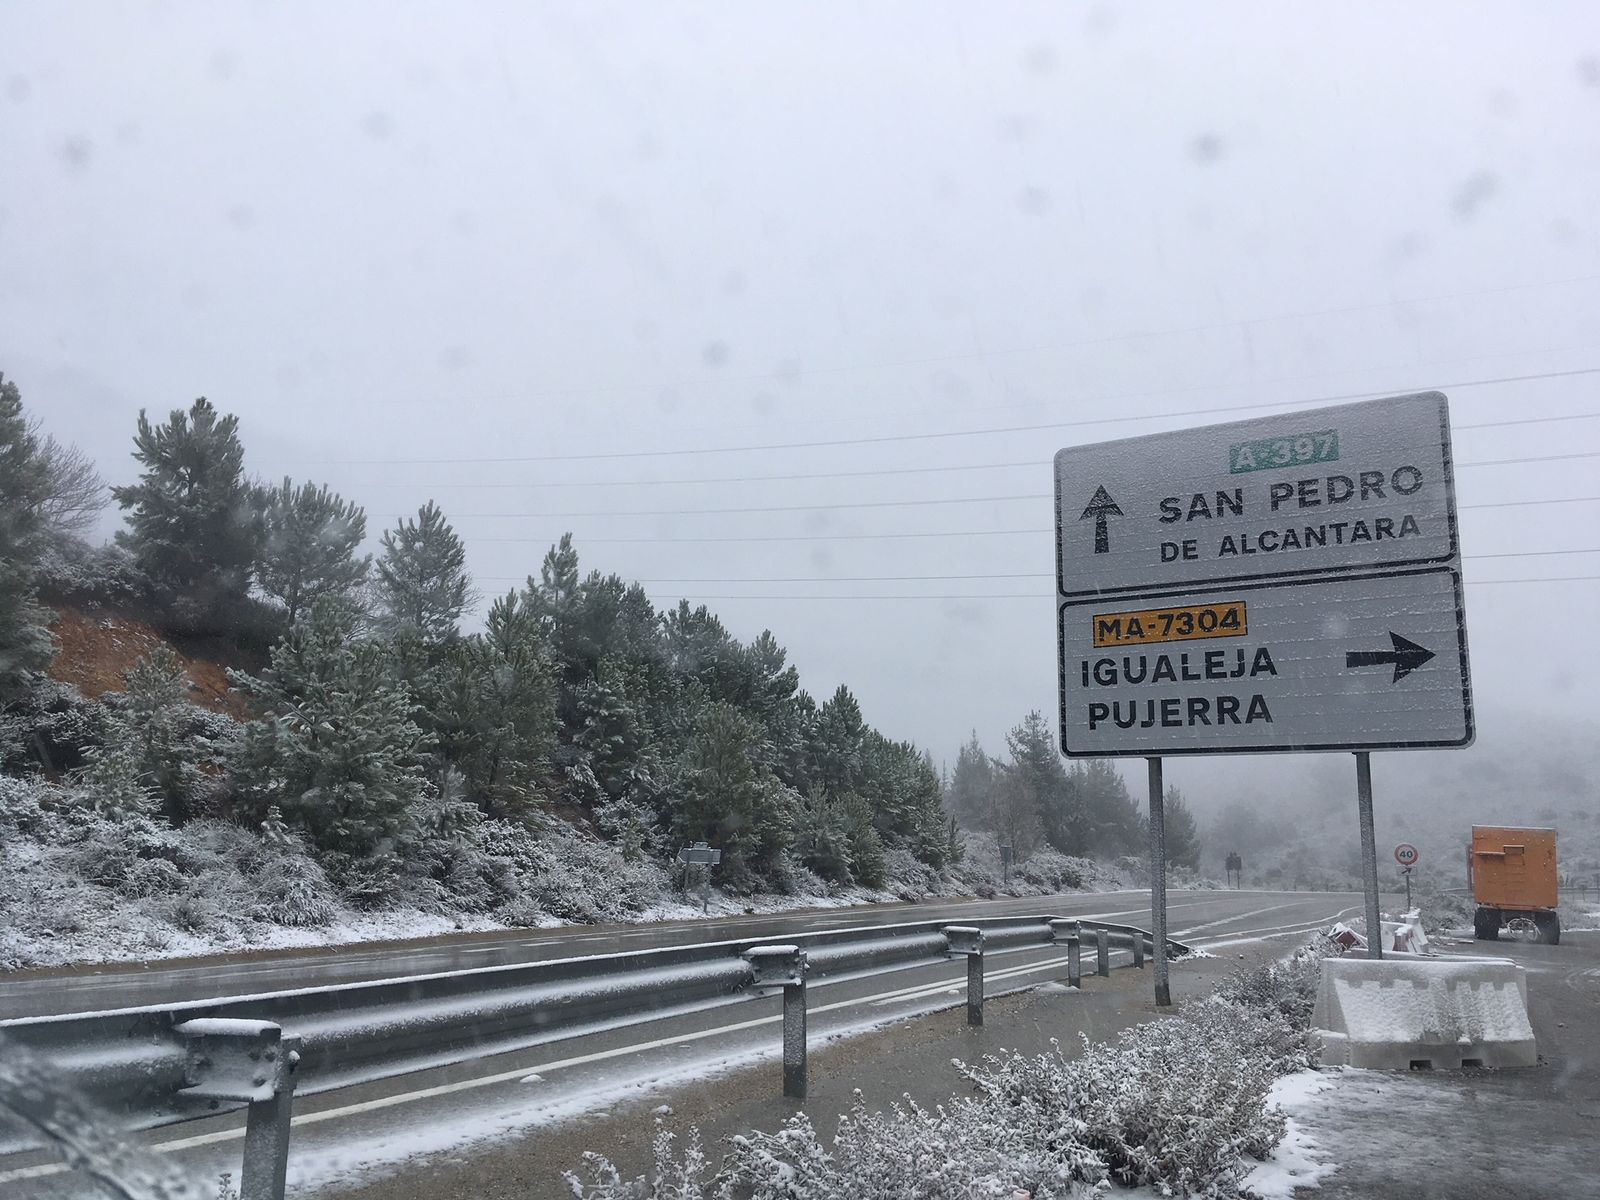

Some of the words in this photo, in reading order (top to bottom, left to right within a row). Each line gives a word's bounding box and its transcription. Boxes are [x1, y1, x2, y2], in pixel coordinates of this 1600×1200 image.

[1235, 433, 1334, 470] A-397
[1158, 488, 1244, 524] SAN
[1270, 465, 1424, 511] PEDRO
[1160, 539, 1199, 563] DE
[1218, 514, 1421, 557] ALCANTARA
[1098, 607, 1242, 642] MA-7304
[1082, 646, 1278, 687] IGUALEJA
[1088, 694, 1274, 730] PUJERRA
[1399, 850, 1413, 859] 40
